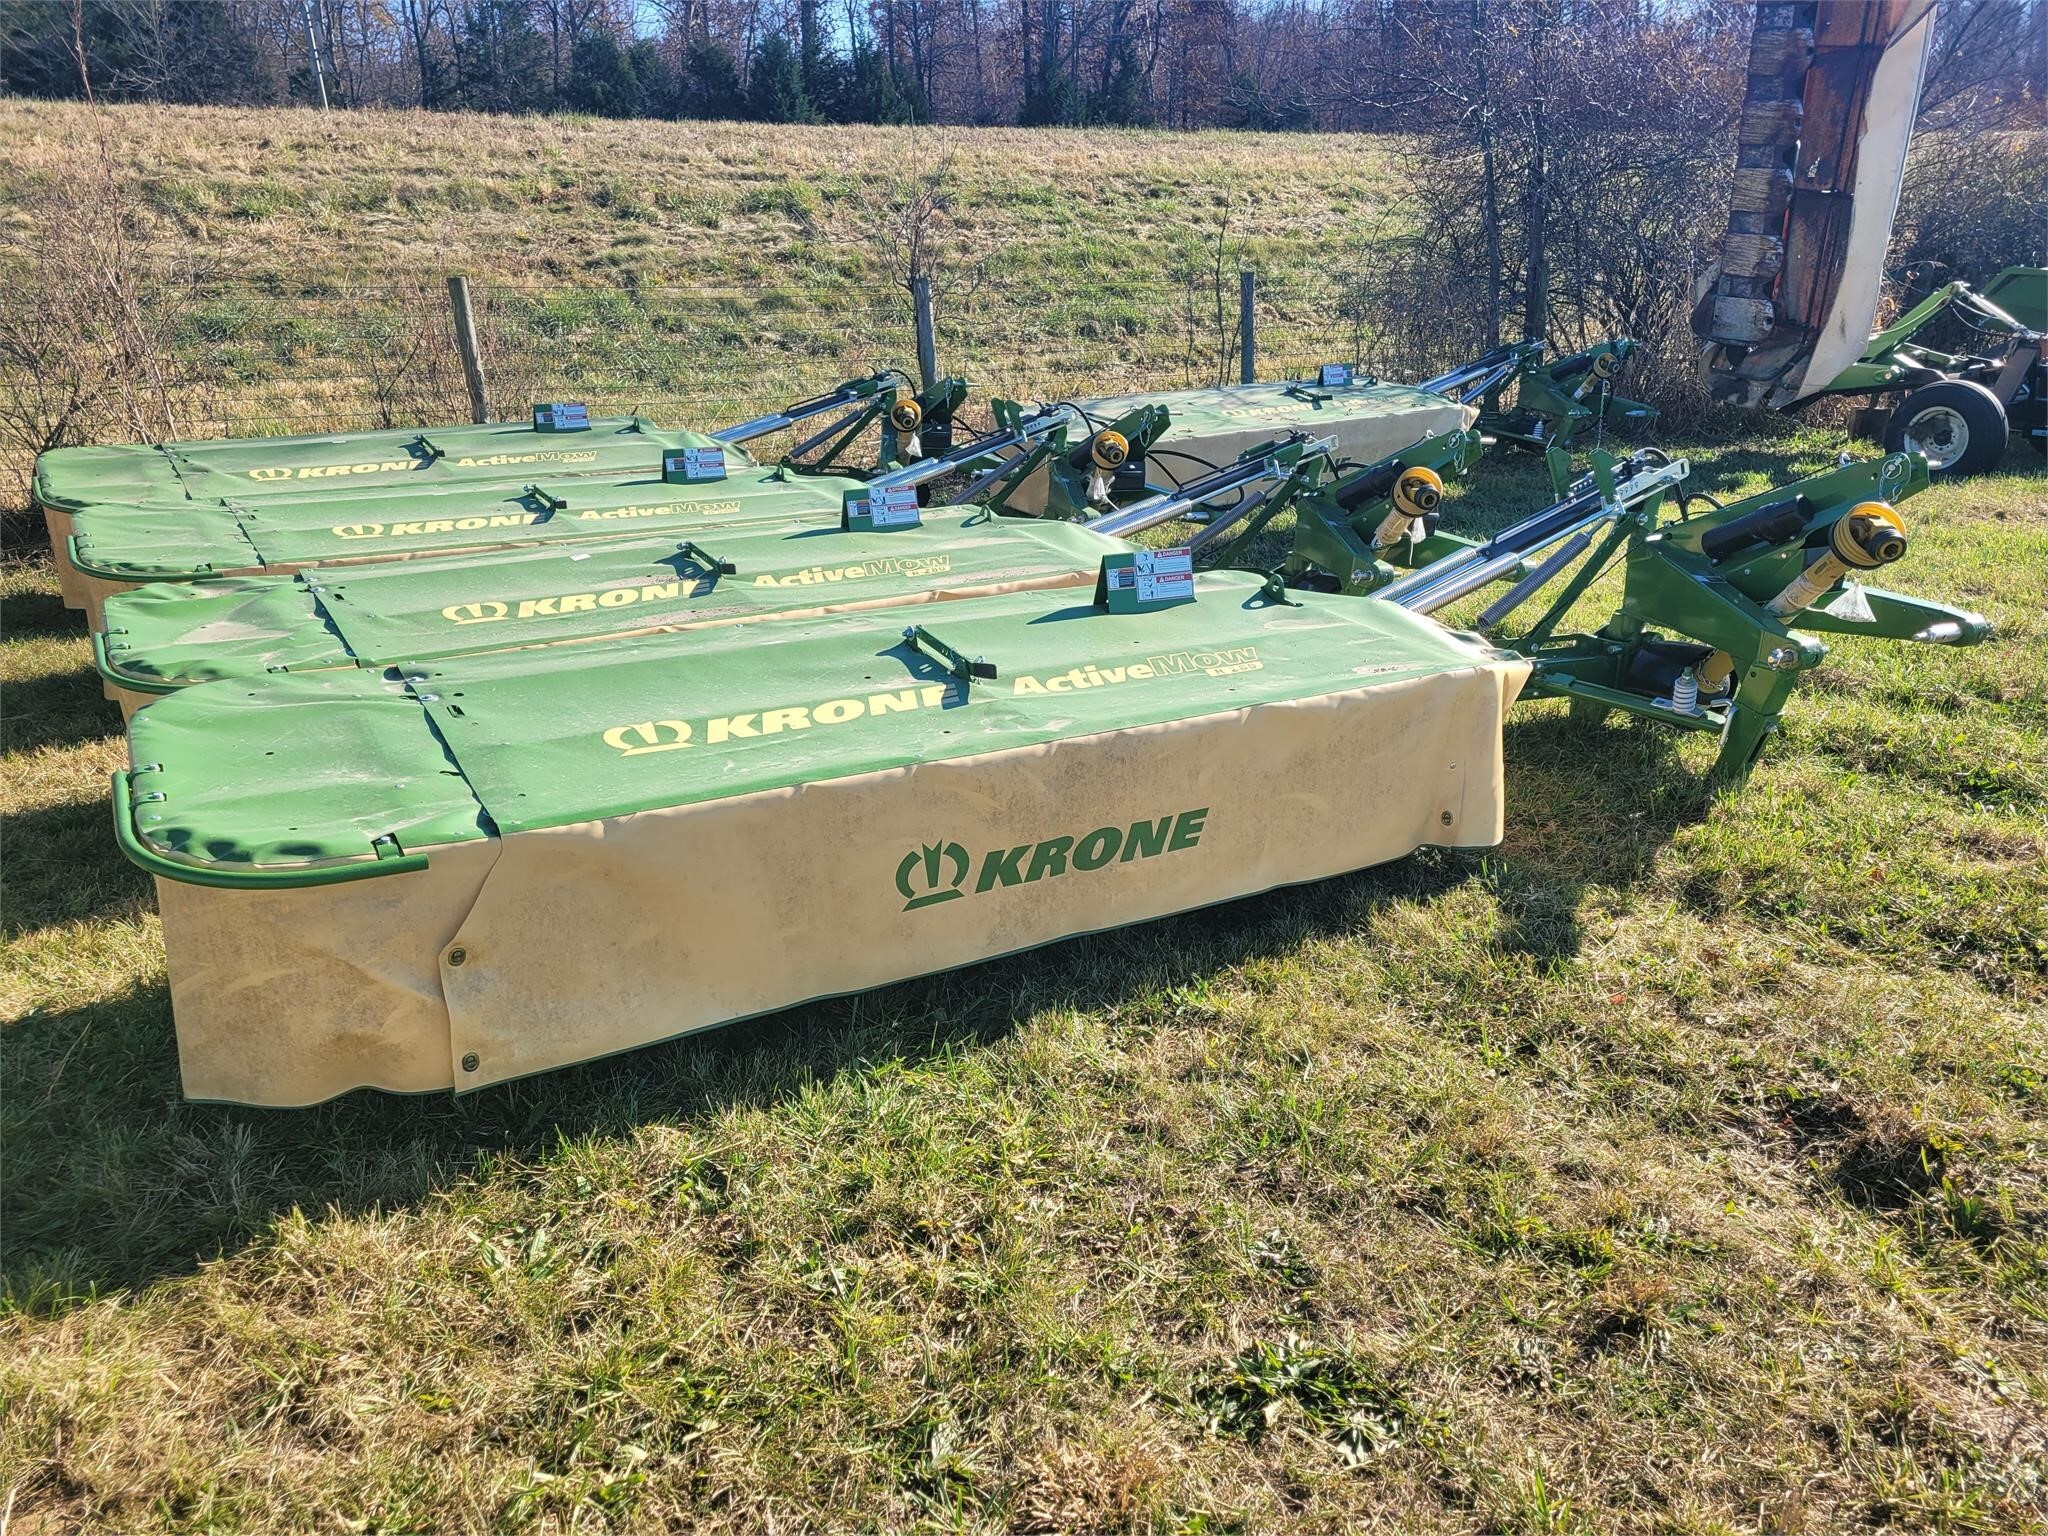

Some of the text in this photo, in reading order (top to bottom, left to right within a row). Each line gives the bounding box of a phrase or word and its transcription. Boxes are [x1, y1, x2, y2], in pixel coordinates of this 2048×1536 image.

[297, 460, 428, 479] KRONE
[456, 450, 597, 467] ActiveMow
[390, 513, 546, 536] KRONE
[579, 501, 741, 520] ActiveMow
[752, 555, 950, 587] ActiveMow
[518, 579, 710, 618] KRONE
[1013, 647, 1258, 695] ActiveMow
[707, 683, 960, 744] KRONE
[975, 807, 1209, 894] KRONE
